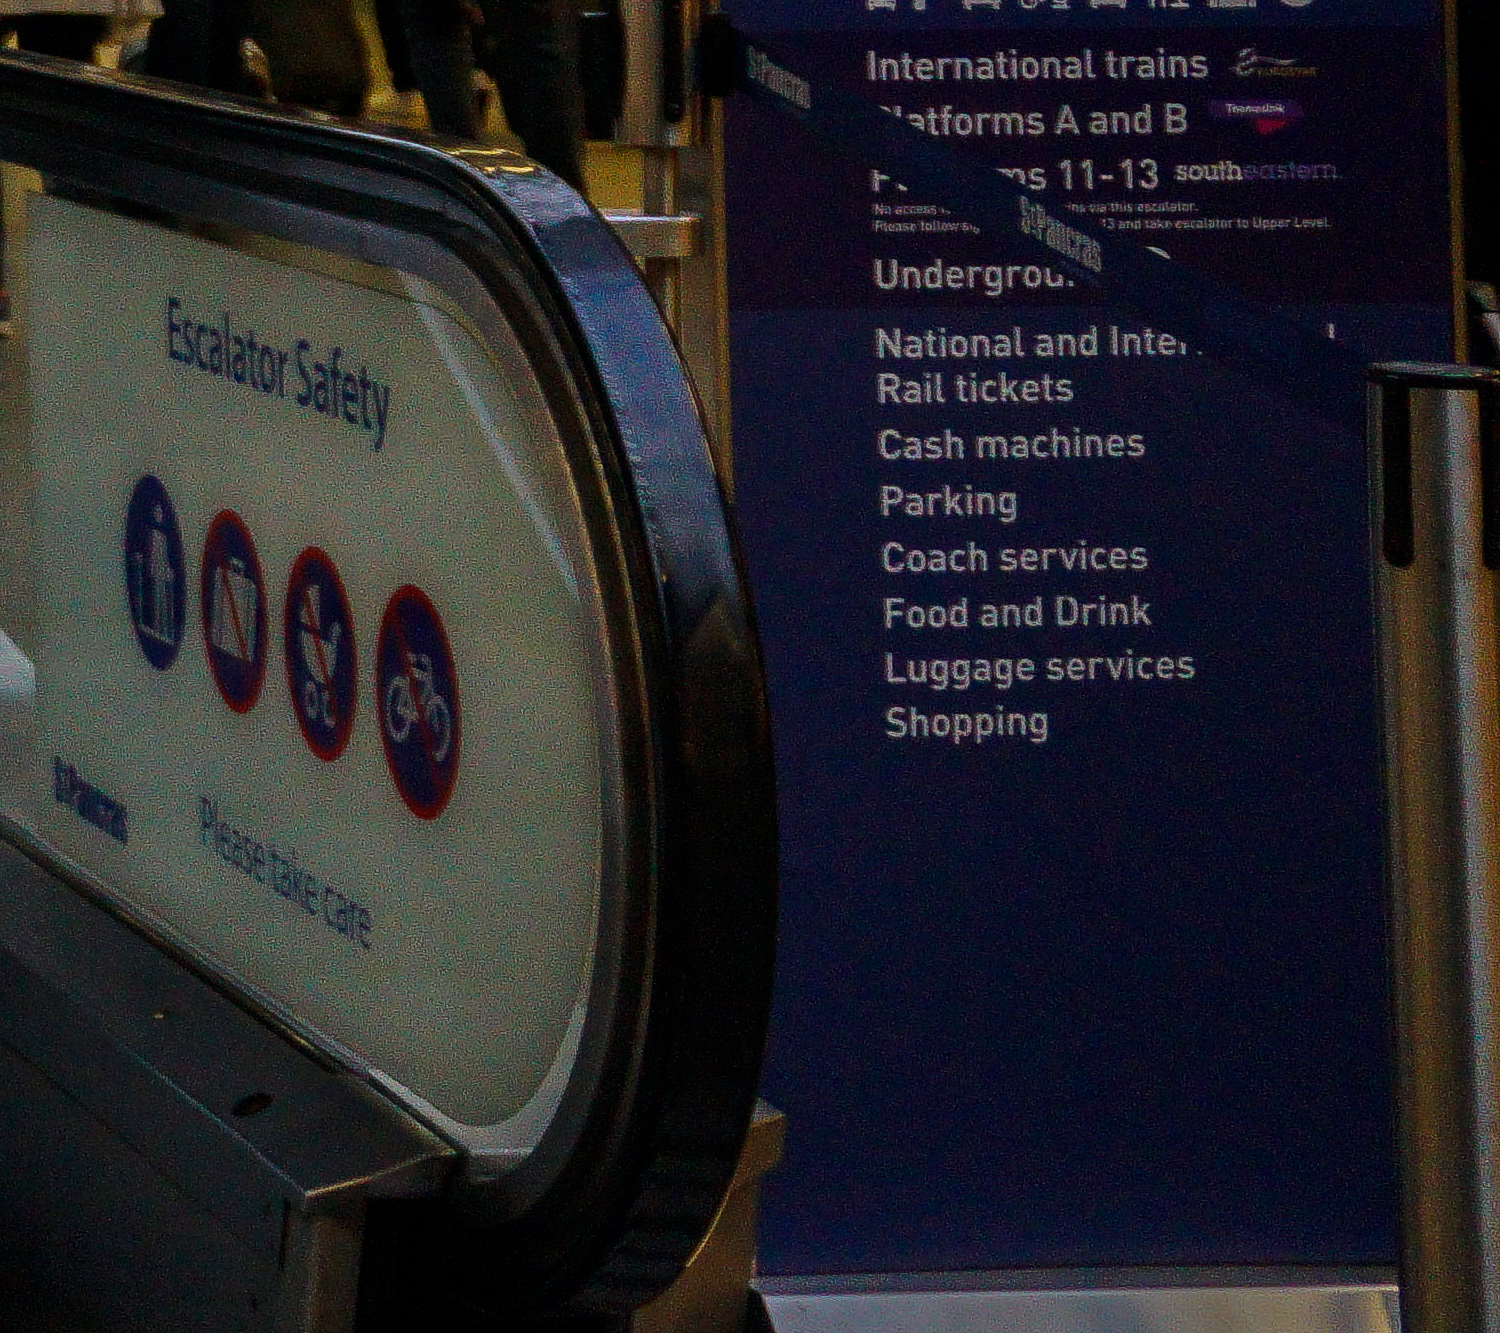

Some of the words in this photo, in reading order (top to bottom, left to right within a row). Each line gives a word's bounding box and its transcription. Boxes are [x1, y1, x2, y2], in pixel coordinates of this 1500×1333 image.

[868, 49, 1096, 81] International
[1105, 48, 1208, 78] trains
[1054, 104, 1081, 136] A
[1089, 104, 1152, 135] and
[1164, 102, 1187, 134] B
[1060, 159, 1158, 190] 11-13
[167, 297, 289, 399] Escalator
[877, 328, 1025, 359] National
[1036, 327, 1098, 358] and
[298, 339, 390, 451] Safety
[878, 373, 945, 403] Rail
[956, 372, 1073, 402] tickets
[879, 429, 964, 460] Cash
[977, 428, 1145, 458] machines
[882, 485, 1017, 523] Parking
[882, 542, 987, 573] Coach
[1000, 540, 1147, 571] services
[885, 598, 967, 628] Food
[981, 597, 1042, 627] and
[1056, 595, 1151, 626] Drink
[886, 653, 1035, 690] Luggage
[1047, 649, 1195, 680] services
[887, 705, 1048, 744] Shopping
